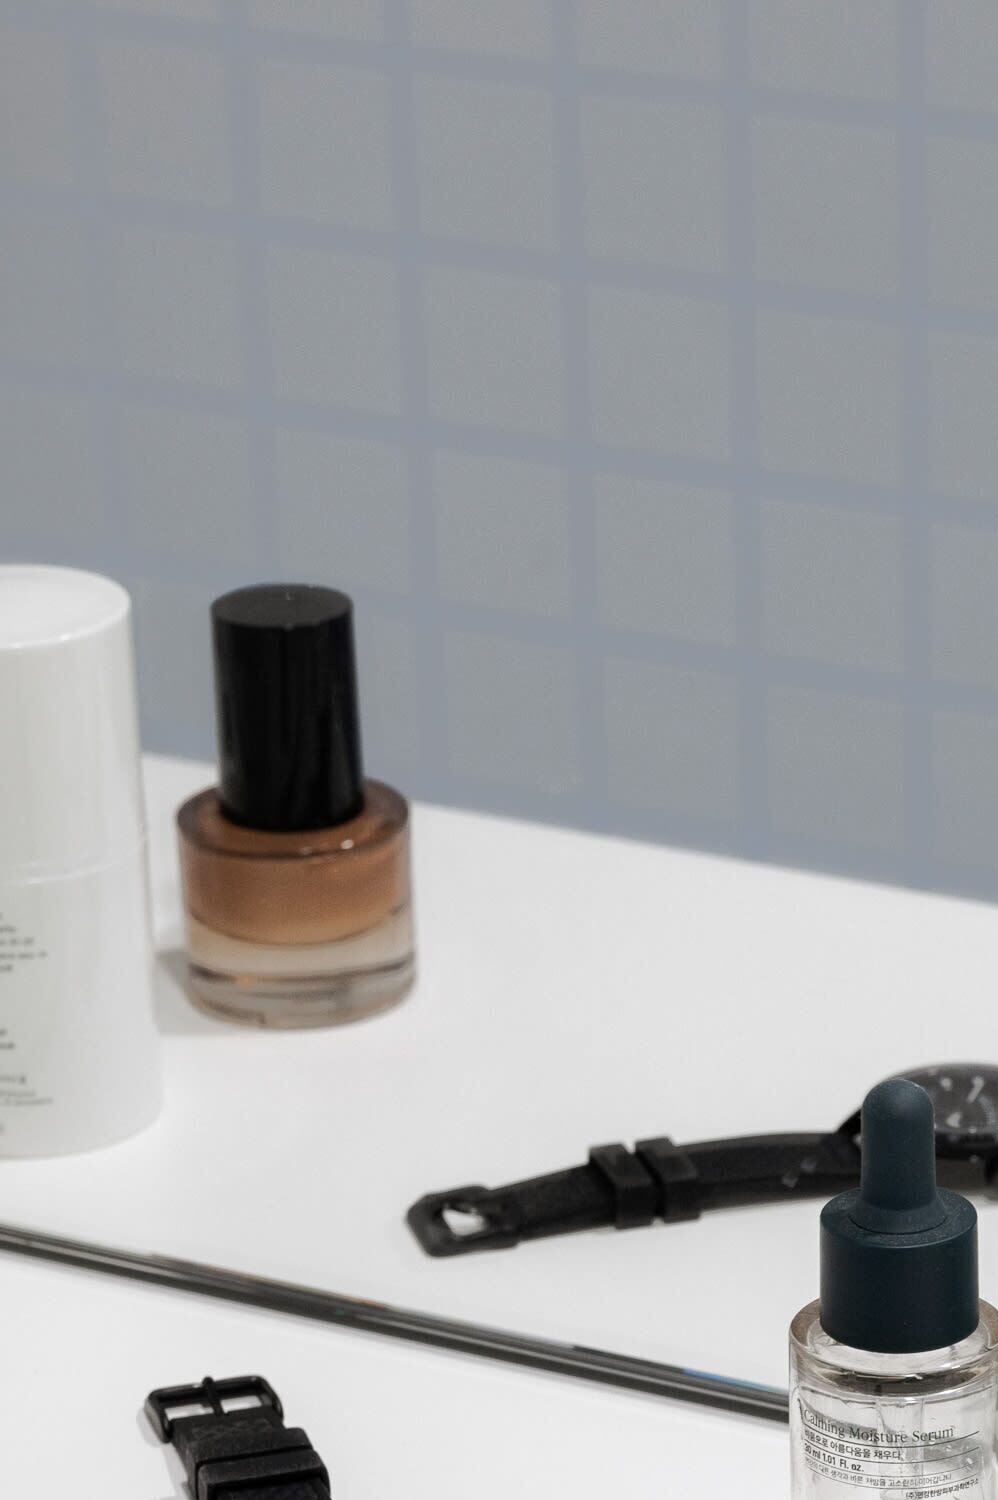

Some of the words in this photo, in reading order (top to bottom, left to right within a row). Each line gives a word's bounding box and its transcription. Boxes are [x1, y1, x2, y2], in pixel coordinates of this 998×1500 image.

[804, 1409, 846, 1439] Calming
[849, 1427, 908, 1443] Moisture
[912, 1428, 954, 1443] Serum
[830, 1441, 871, 1459] 아름다움을
[822, 1453, 836, 1466] 1.01
[851, 1463, 865, 1473] oz.
